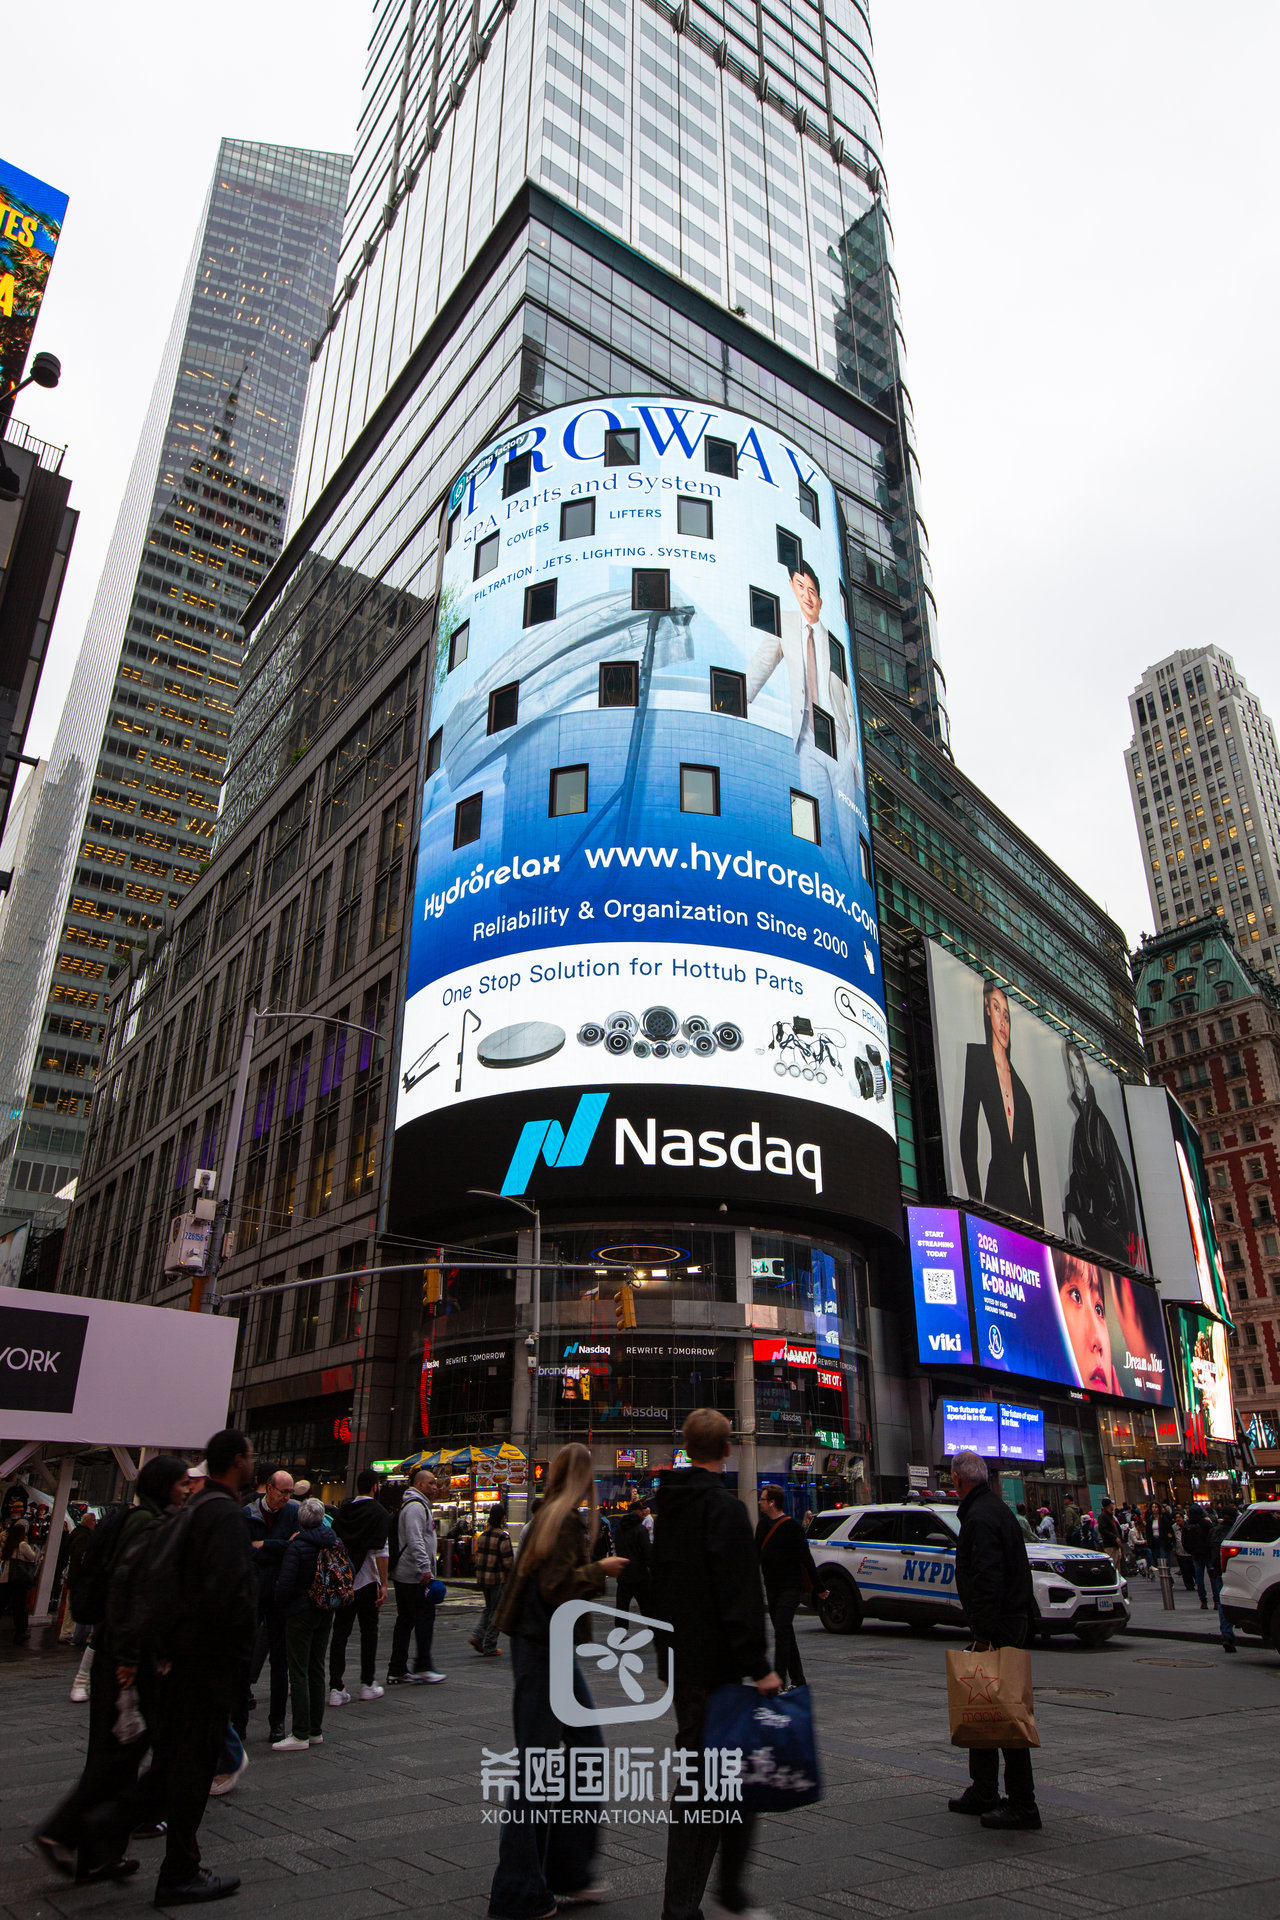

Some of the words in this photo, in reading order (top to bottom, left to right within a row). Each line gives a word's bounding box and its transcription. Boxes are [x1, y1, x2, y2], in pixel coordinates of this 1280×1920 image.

[494, 433, 526, 458] factory
[463, 405, 820, 522] PROWAY
[464, 514, 498, 550] SPA
[505, 486, 562, 520] Parts
[570, 473, 617, 496] and
[628, 471, 722, 498] System
[609, 508, 662, 519] LIFTERS
[506, 522, 550, 547] COVERS
[474, 565, 533, 602] FILTRATION
[542, 554, 572, 570] JETS
[582, 547, 646, 561] LIGHTING
[658, 547, 717, 563] SYSTEMS
[585, 842, 879, 945] www.hydrorelax.com
[473, 906, 570, 942] Reliability
[578, 901, 595, 920] &
[604, 899, 749, 926] Organization
[756, 911, 807, 941] Since
[813, 928, 848, 959] 2000
[442, 985, 472, 1006] One
[479, 973, 521, 994] Stop
[530, 959, 620, 984] Solution
[629, 958, 662, 976] for
[672, 959, 746, 983] Hottub
[755, 968, 804, 995] Parts
[615, 1117, 823, 1195] Nasdaq
[917, 1240, 954, 1248] STREAMING
[926, 1250, 947, 1258] TODAY
[977, 1233, 998, 1254] 2026
[980, 1251, 999, 1274] FAN
[1000, 1258, 1041, 1288] FAVORITE
[981, 1272, 1026, 1303] K-DRAMA
[579, 1345, 611, 1355] Nasdaq
[626, 1347, 664, 1355] REWRITE
[668, 1347, 716, 1356] TOMORROW
[1123, 1351, 1147, 1371] Dream
[1150, 1353, 1165, 1373] You
[623, 1406, 668, 1420] Nasdaq
[946, 1405, 958, 1413] The
[959, 1406, 978, 1414] future
[947, 1413, 966, 1421] spend
[1001, 1408, 1009, 1416] The
[1027, 1413, 1039, 1422] spend
[903, 1559, 955, 1585] NYPD
